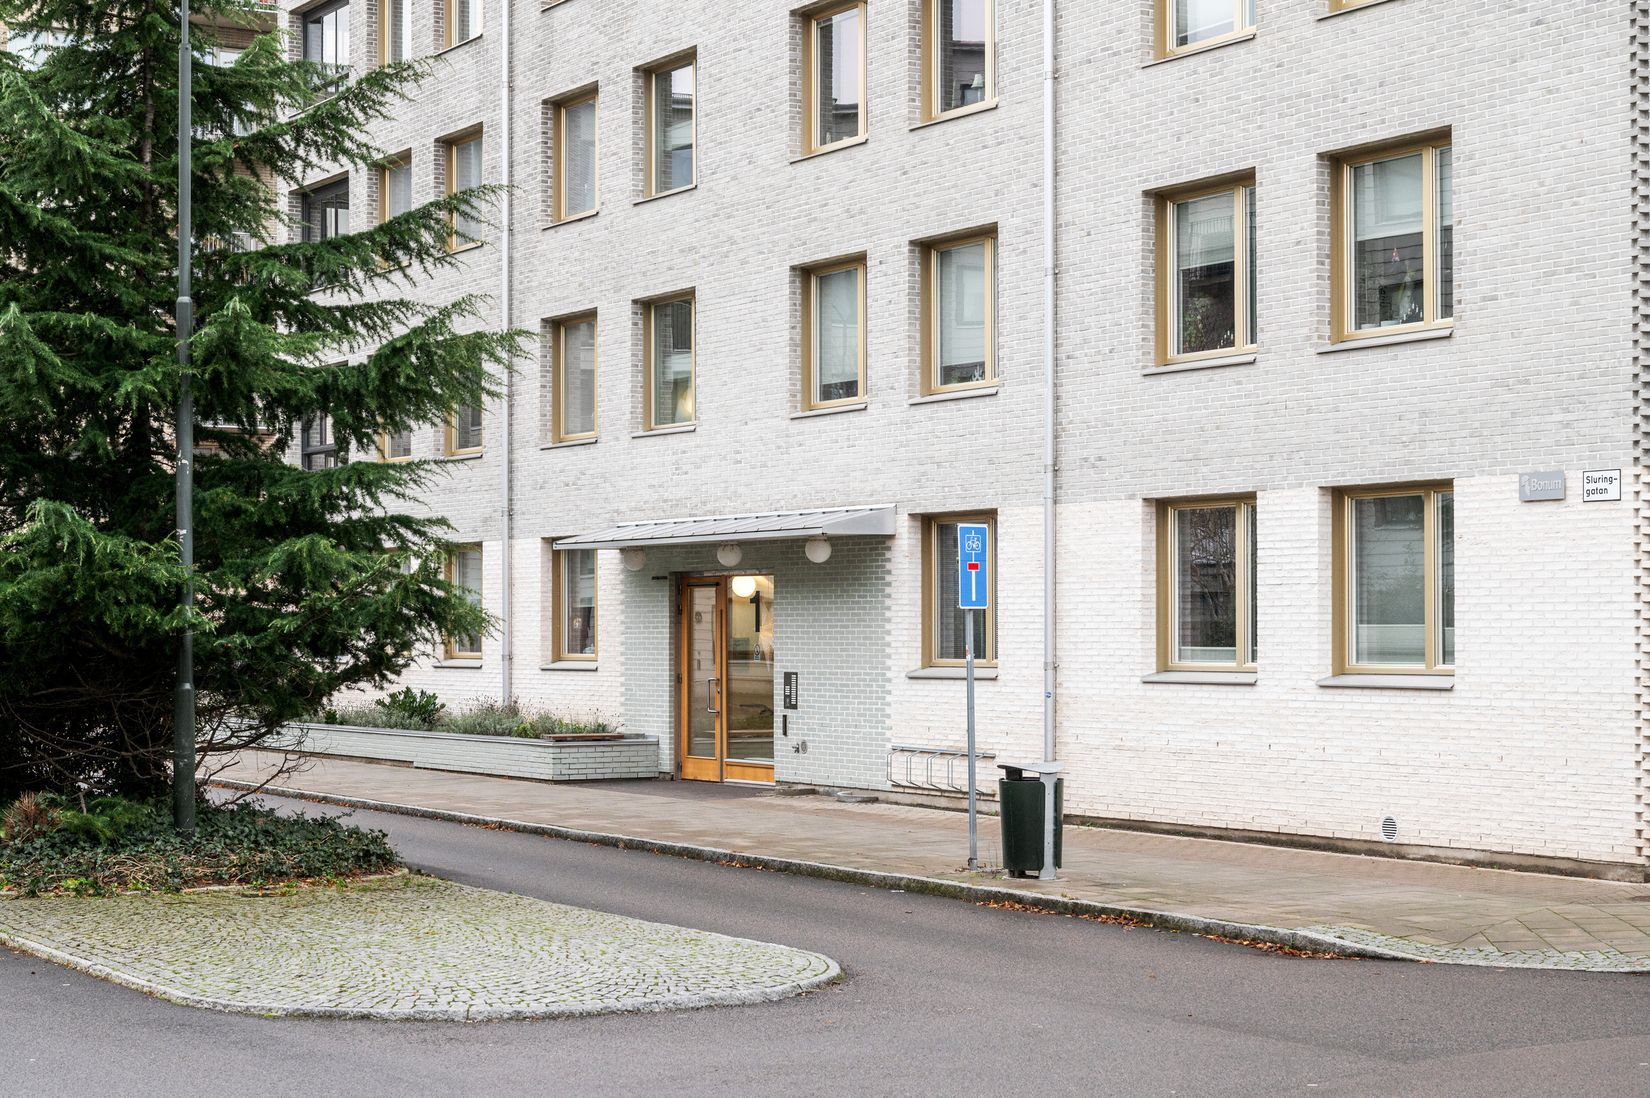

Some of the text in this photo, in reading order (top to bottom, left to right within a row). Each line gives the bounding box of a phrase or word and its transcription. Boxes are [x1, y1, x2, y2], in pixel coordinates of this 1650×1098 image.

[1531, 479, 1561, 490] Bonum
[1585, 475, 1618, 484] Sluring-
[1586, 487, 1608, 497] gatan
[750, 590, 760, 632] 1
